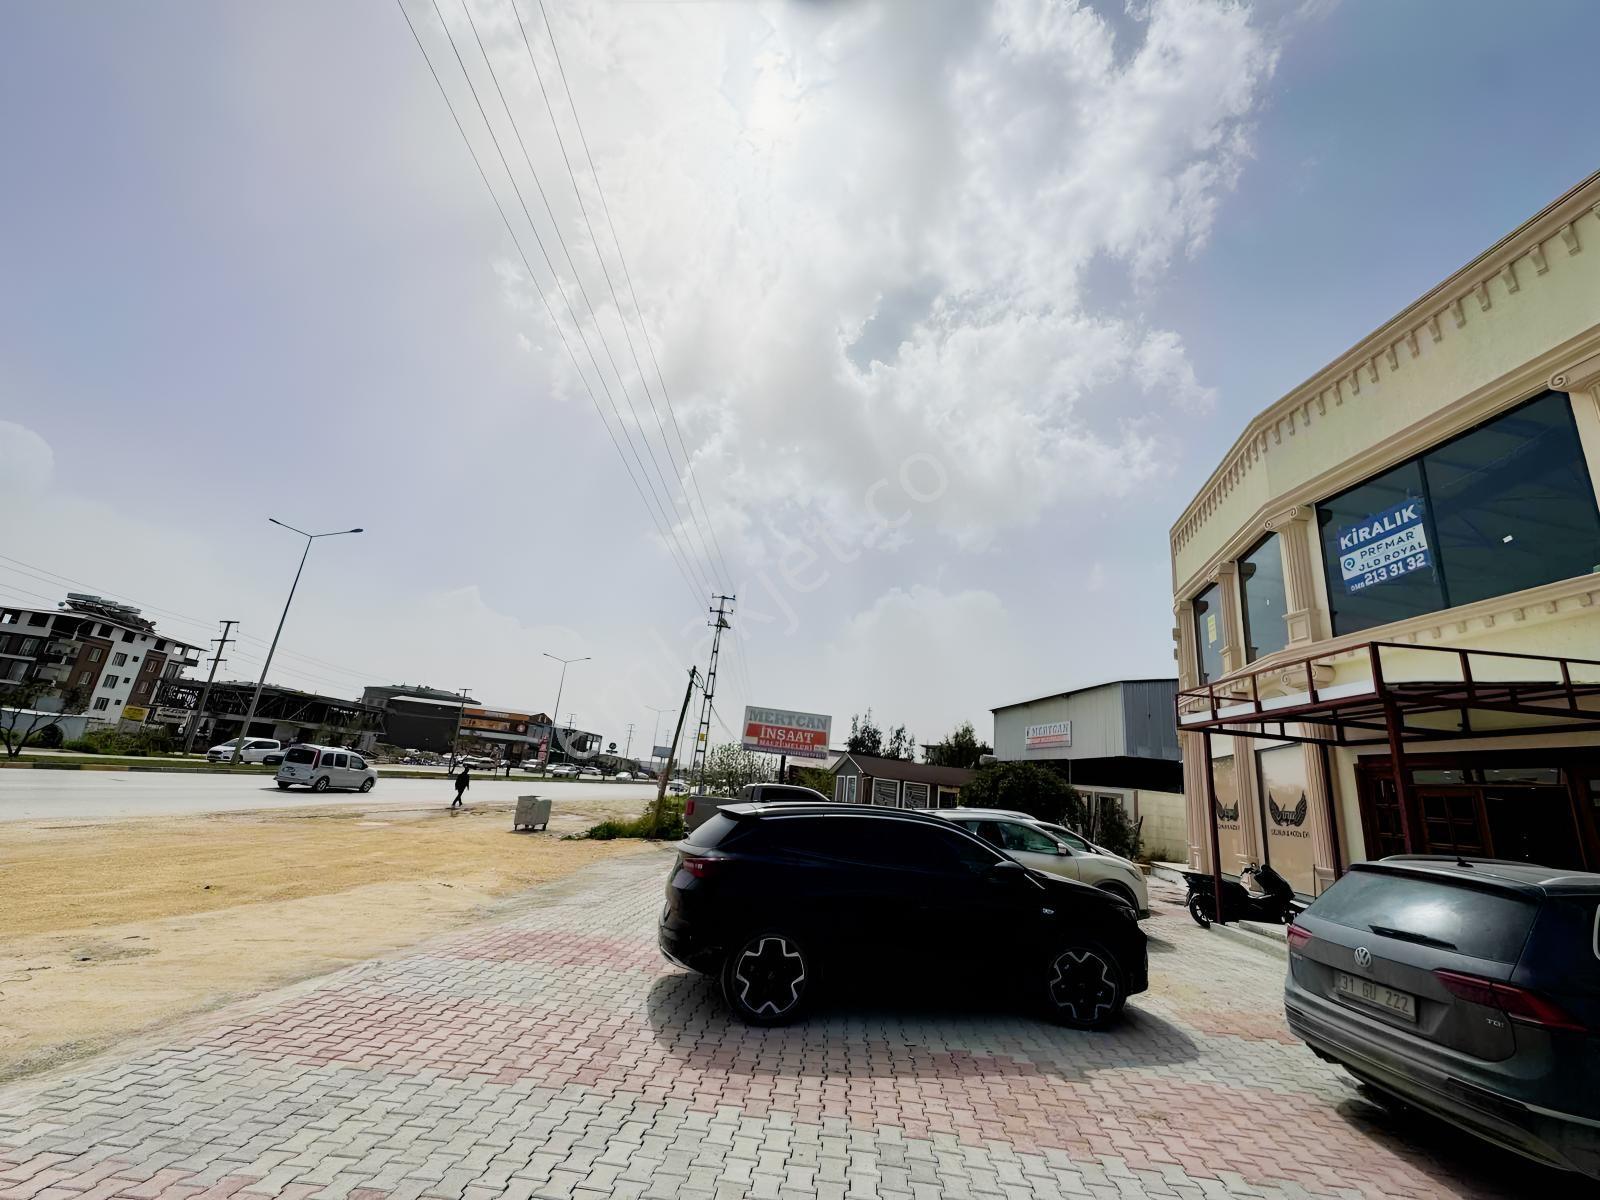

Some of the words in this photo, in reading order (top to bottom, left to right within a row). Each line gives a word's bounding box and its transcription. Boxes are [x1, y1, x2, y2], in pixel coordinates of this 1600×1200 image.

[1384, 542, 1425, 562] ROYAL
[1364, 567, 1388, 586] 213
[1390, 561, 1405, 577] 31
[1407, 553, 1426, 570] 32
[1385, 990, 1409, 1013] 222
